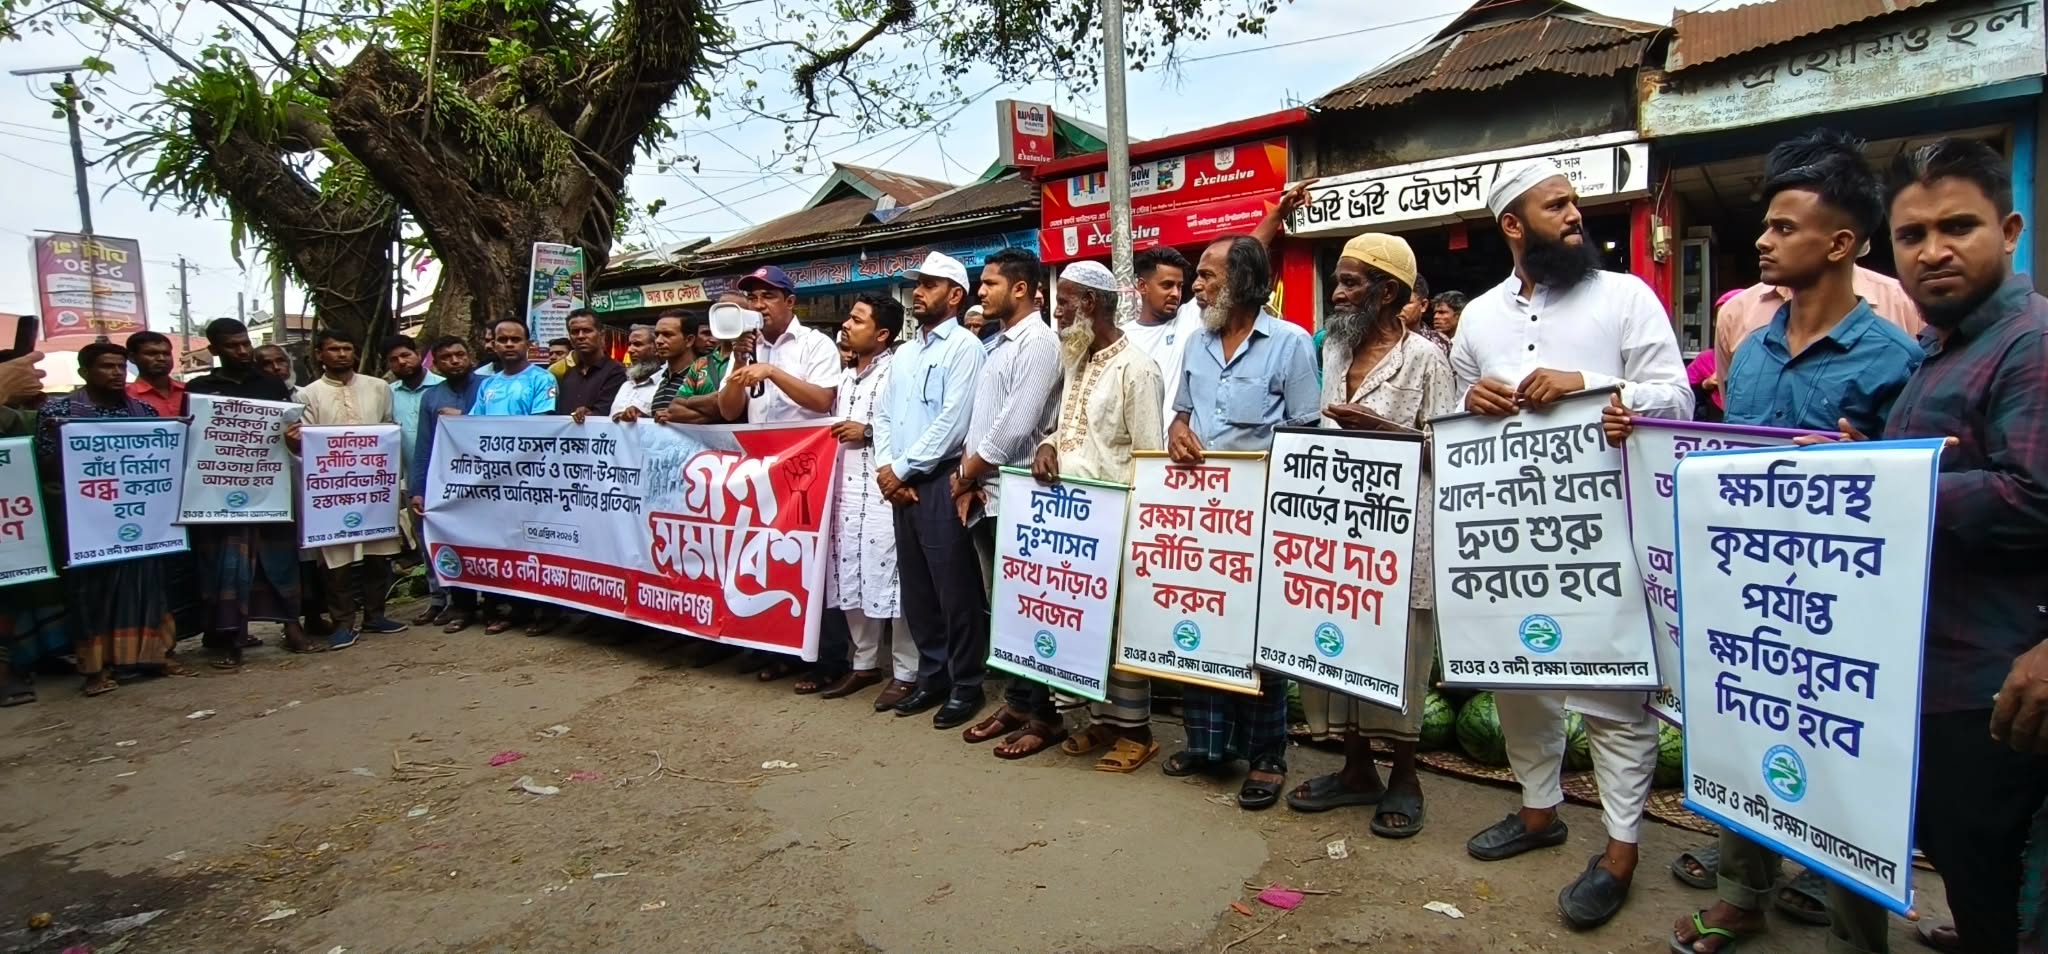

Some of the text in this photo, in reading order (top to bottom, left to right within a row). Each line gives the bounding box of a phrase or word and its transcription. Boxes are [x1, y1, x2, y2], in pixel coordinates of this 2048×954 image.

[1018, 111, 1043, 122] RAINBOW
[1018, 149, 1050, 162] Exclusive
[1564, 158, 1580, 167] দাস
[1194, 169, 1255, 187] Exclusive
[1307, 190, 1341, 222] ভাই
[1349, 183, 1388, 218] ভাই
[1399, 165, 1482, 212] ট্রেডার্স
[1088, 223, 1160, 245] Excsive
[678, 284, 700, 300] স্টোর
[205, 427, 280, 445] পিআইসি কে
[211, 416, 280, 431] কর্মকর্তা ও
[70, 428, 180, 452] অপ্রয়োজনীয়
[216, 446, 269, 458] আইনের
[327, 433, 378, 449] অনিয়ম
[480, 433, 616, 456] হাওরে ফসল রক্ষা বাঁধে
[1447, 422, 1607, 468] বন্যা নিয়ন্ত্রণে
[83, 454, 170, 476] বাঁধ নির্মাণ
[198, 460, 282, 473] আওতায় নিয়ে
[361, 454, 387, 471] বন্ধে
[450, 455, 471, 475] পানি
[474, 456, 512, 479] উন্নয়ন
[516, 455, 546, 477] বোর্ড
[550, 465, 560, 479] ও
[1164, 465, 1230, 492] ফসল
[1284, 445, 1402, 493] পানি উন্নয়ন
[79, 478, 172, 500] বন্ধ করতে
[203, 475, 274, 487] আসতে হবে
[307, 470, 397, 492] বিচারবিভাগীয়
[685, 453, 780, 526] গণ
[1439, 465, 1546, 512] খাল-নদী
[1554, 469, 1622, 503] খনন
[1718, 460, 1875, 522] ক্ষতিগ্রস্থ
[114, 502, 146, 519] হবে
[214, 508, 229, 517] নদী
[251, 510, 288, 518] আন্দোলন
[313, 488, 390, 509] হস্তক্ষেপ চাই
[443, 484, 500, 501] প্রশাসনের
[600, 488, 641, 515] প্রতিবাদ
[1271, 486, 1412, 538] বোর্ডের দুর্নীতি
[1139, 497, 1253, 536] রক্ষা বাঁধে
[539, 527, 555, 539] এপ্রিল
[1016, 524, 1099, 561] দুঃশাসন
[1456, 514, 1603, 560] দ্রুত শুরু
[74, 550, 96, 560] হাওর
[107, 545, 122, 555] নদী
[124, 544, 143, 553] রক্ষা
[145, 539, 183, 551] আন্দোলন
[652, 504, 820, 617] সমাবেশ
[1132, 533, 1254, 583] দুর্নীতি বন্ধ
[1273, 530, 1397, 586] রুখে দাও
[1707, 526, 1885, 579] কৃষকদের
[464, 555, 713, 626] হাওর ও নদী রক্ষা আন্দোলন, জামালগঞ্জ
[1002, 556, 1107, 600] রুখে দাঁড়াও
[1449, 561, 1622, 604] করতে হবে
[1018, 591, 1083, 631] সর্বজন
[1153, 583, 1226, 616] করুন
[1284, 571, 1383, 626] জনগণ
[1742, 572, 1836, 635] পর্যাপ্ত
[994, 648, 1100, 690] হাওর ও নদী রক্ষা আন্দোলন
[1124, 647, 1252, 680] হাওর ও নদী রক্ষা আন্দোলন
[1261, 646, 1399, 698] হাওর ও নদী রক্ষা আন্দোলন
[1450, 656, 1648, 677] হাওর ও নদী রক্ষা আন্দোলন
[1708, 625, 1879, 700] ক্ষতিপুরন
[1715, 671, 1864, 758] দিতে হবে
[1693, 774, 1897, 885] হাওর ও নদী রক্ষা আন্দোলন
